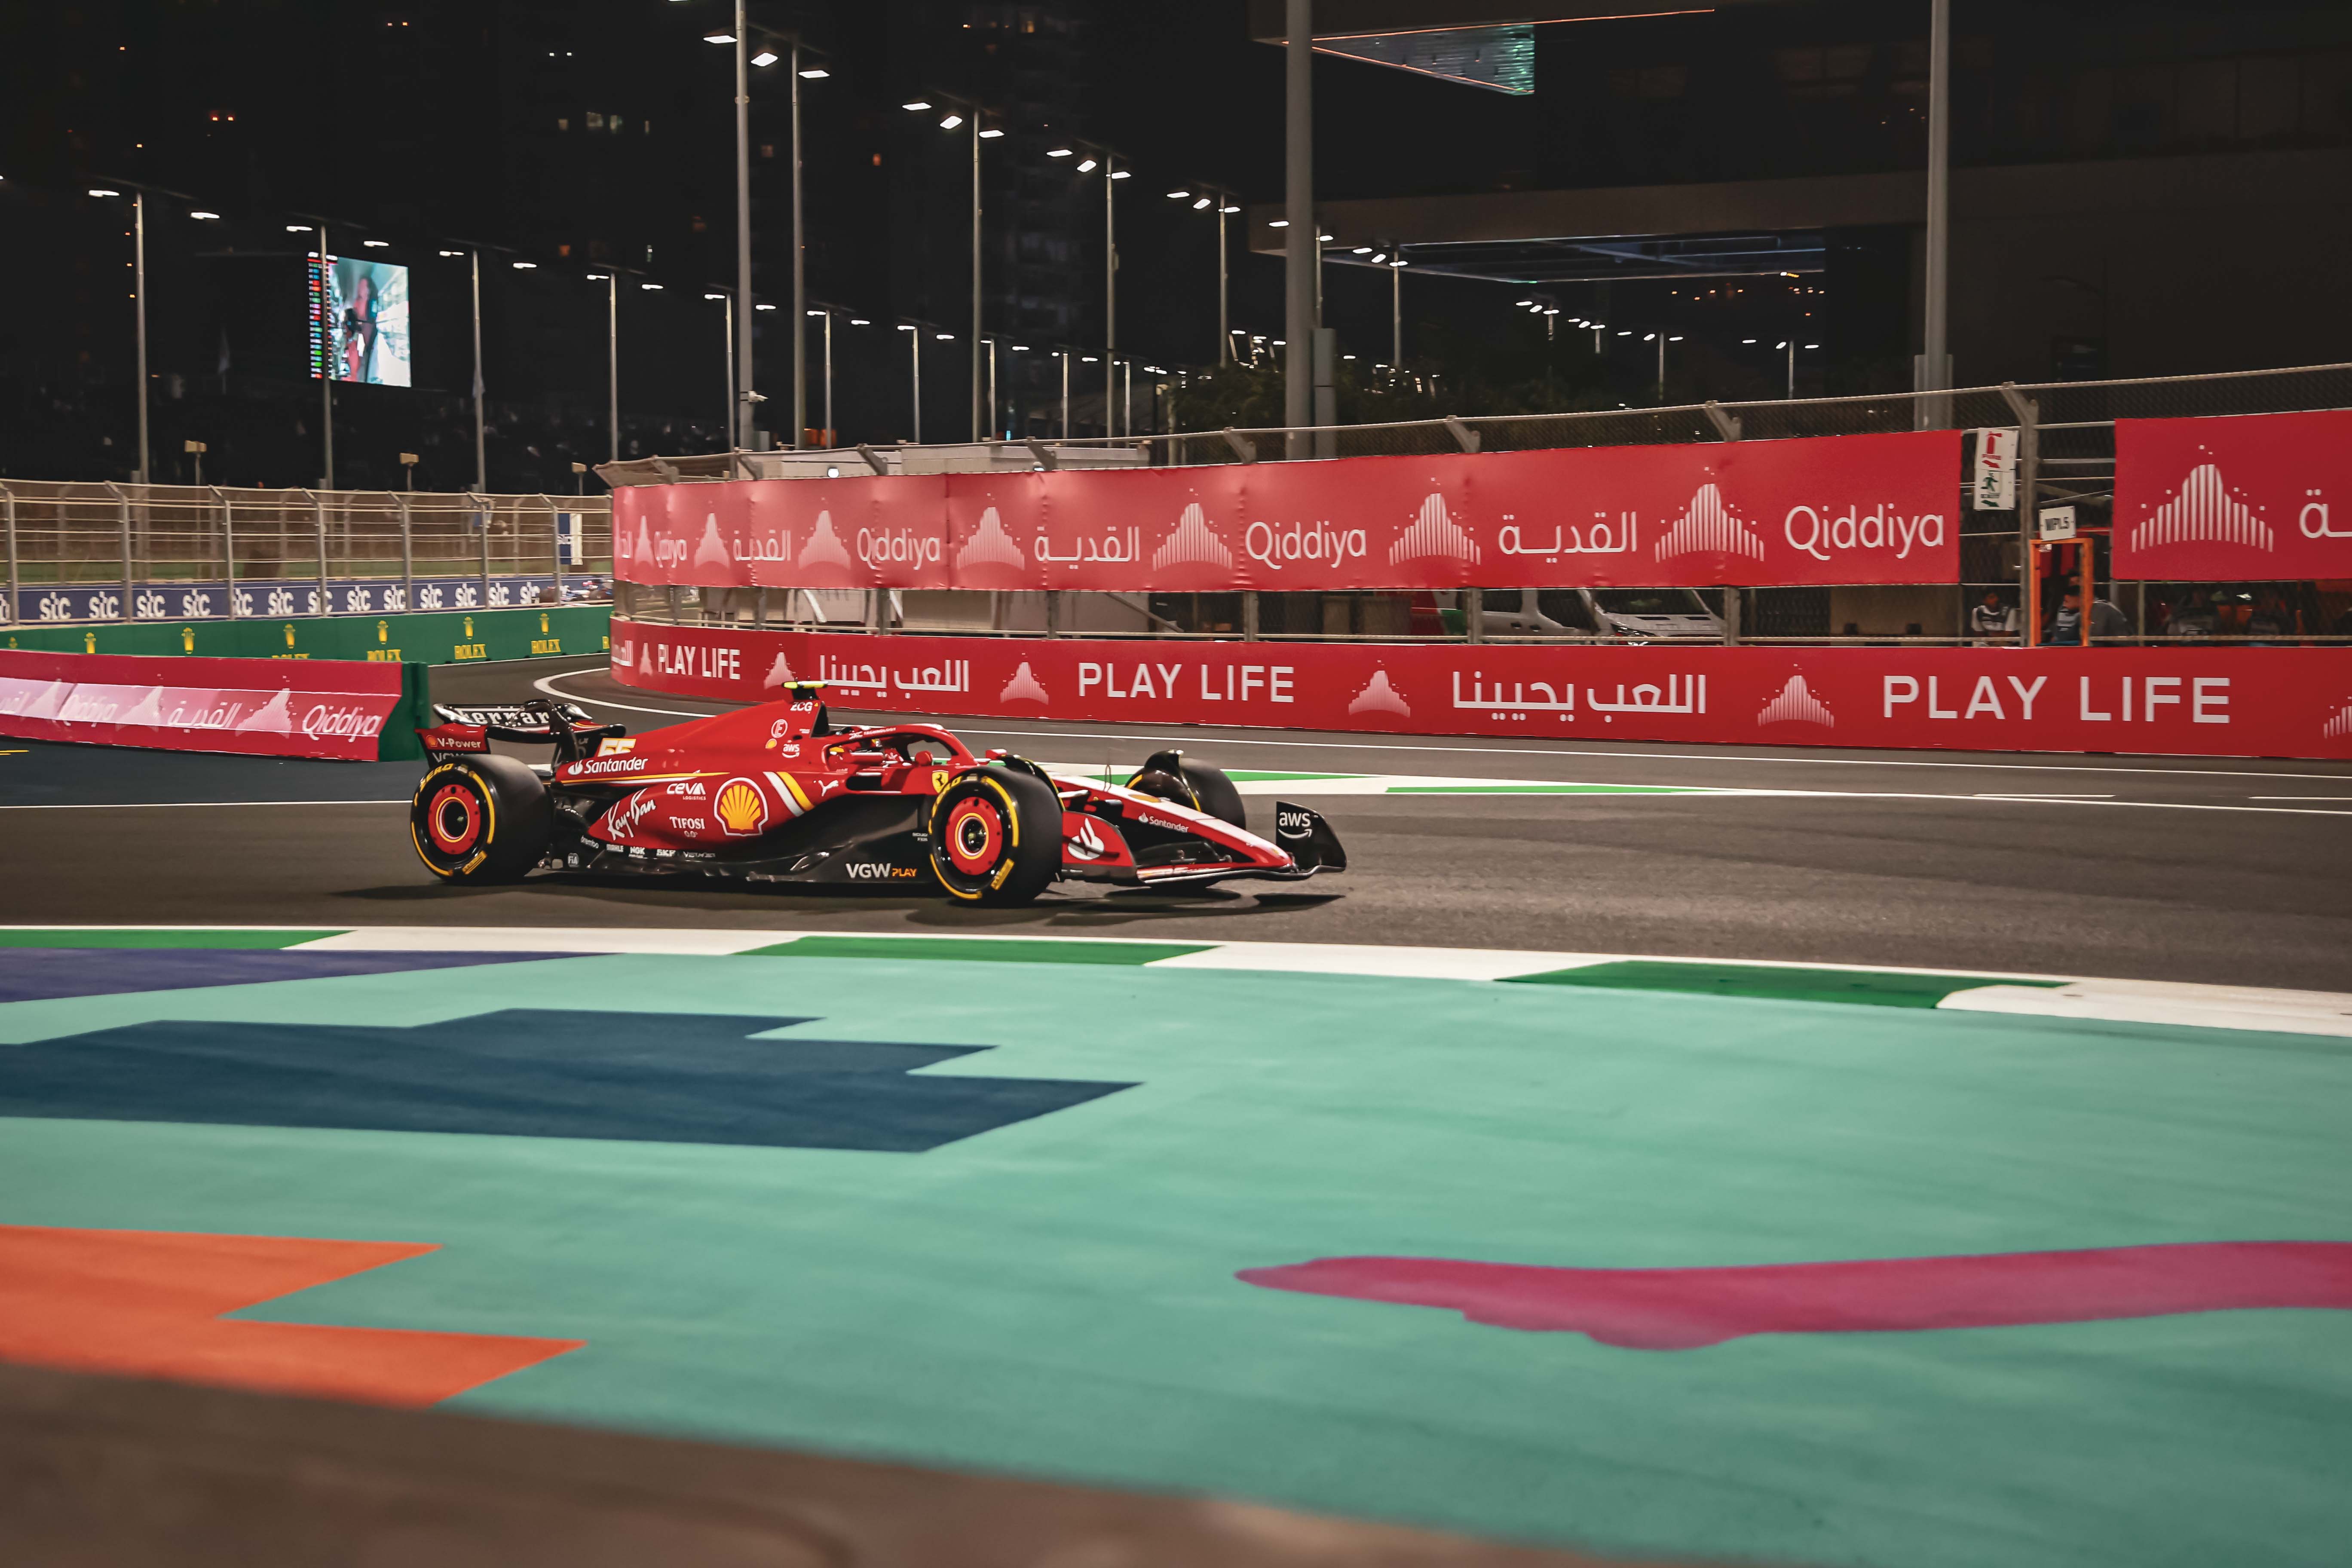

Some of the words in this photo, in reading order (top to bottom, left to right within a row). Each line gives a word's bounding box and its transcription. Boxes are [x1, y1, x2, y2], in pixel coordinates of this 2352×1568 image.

[1244, 521, 1367, 570] Qiddiya
[1498, 511, 1636, 563] القدية
[1785, 503, 1944, 561] Qiddiya
[1034, 526, 1140, 570] القدية
[40, 591, 71, 620] stc
[89, 591, 119, 619] stc
[136, 590, 165, 618] stc
[182, 588, 211, 616] stc
[268, 587, 294, 615] stc
[346, 585, 371, 612] stc
[420, 584, 443, 609] stc
[455, 582, 477, 607] stc
[454, 644, 487, 660] ROLEX
[531, 639, 561, 654] ROLEX
[658, 643, 696, 675] PLAY
[701, 647, 741, 680] LIFE
[1078, 662, 1182, 699] PLAY
[1201, 664, 1294, 703] LIFE
[1452, 671, 1575, 722] يحيينا
[1586, 674, 1706, 723] اللعب
[1883, 675, 2048, 721] PLAY
[2079, 676, 2230, 723] LIFE
[302, 704, 383, 743] Qiddiya
[437, 738, 481, 749] V-Power
[783, 744, 800, 752] aws
[584, 756, 649, 774] Santander
[669, 816, 705, 829] TIFOSI
[1148, 816, 1189, 833] Santander
[1279, 812, 1311, 827] aws
[656, 848, 676, 857] SKF
[845, 863, 891, 879] VGW
[892, 868, 917, 877] PLAY
